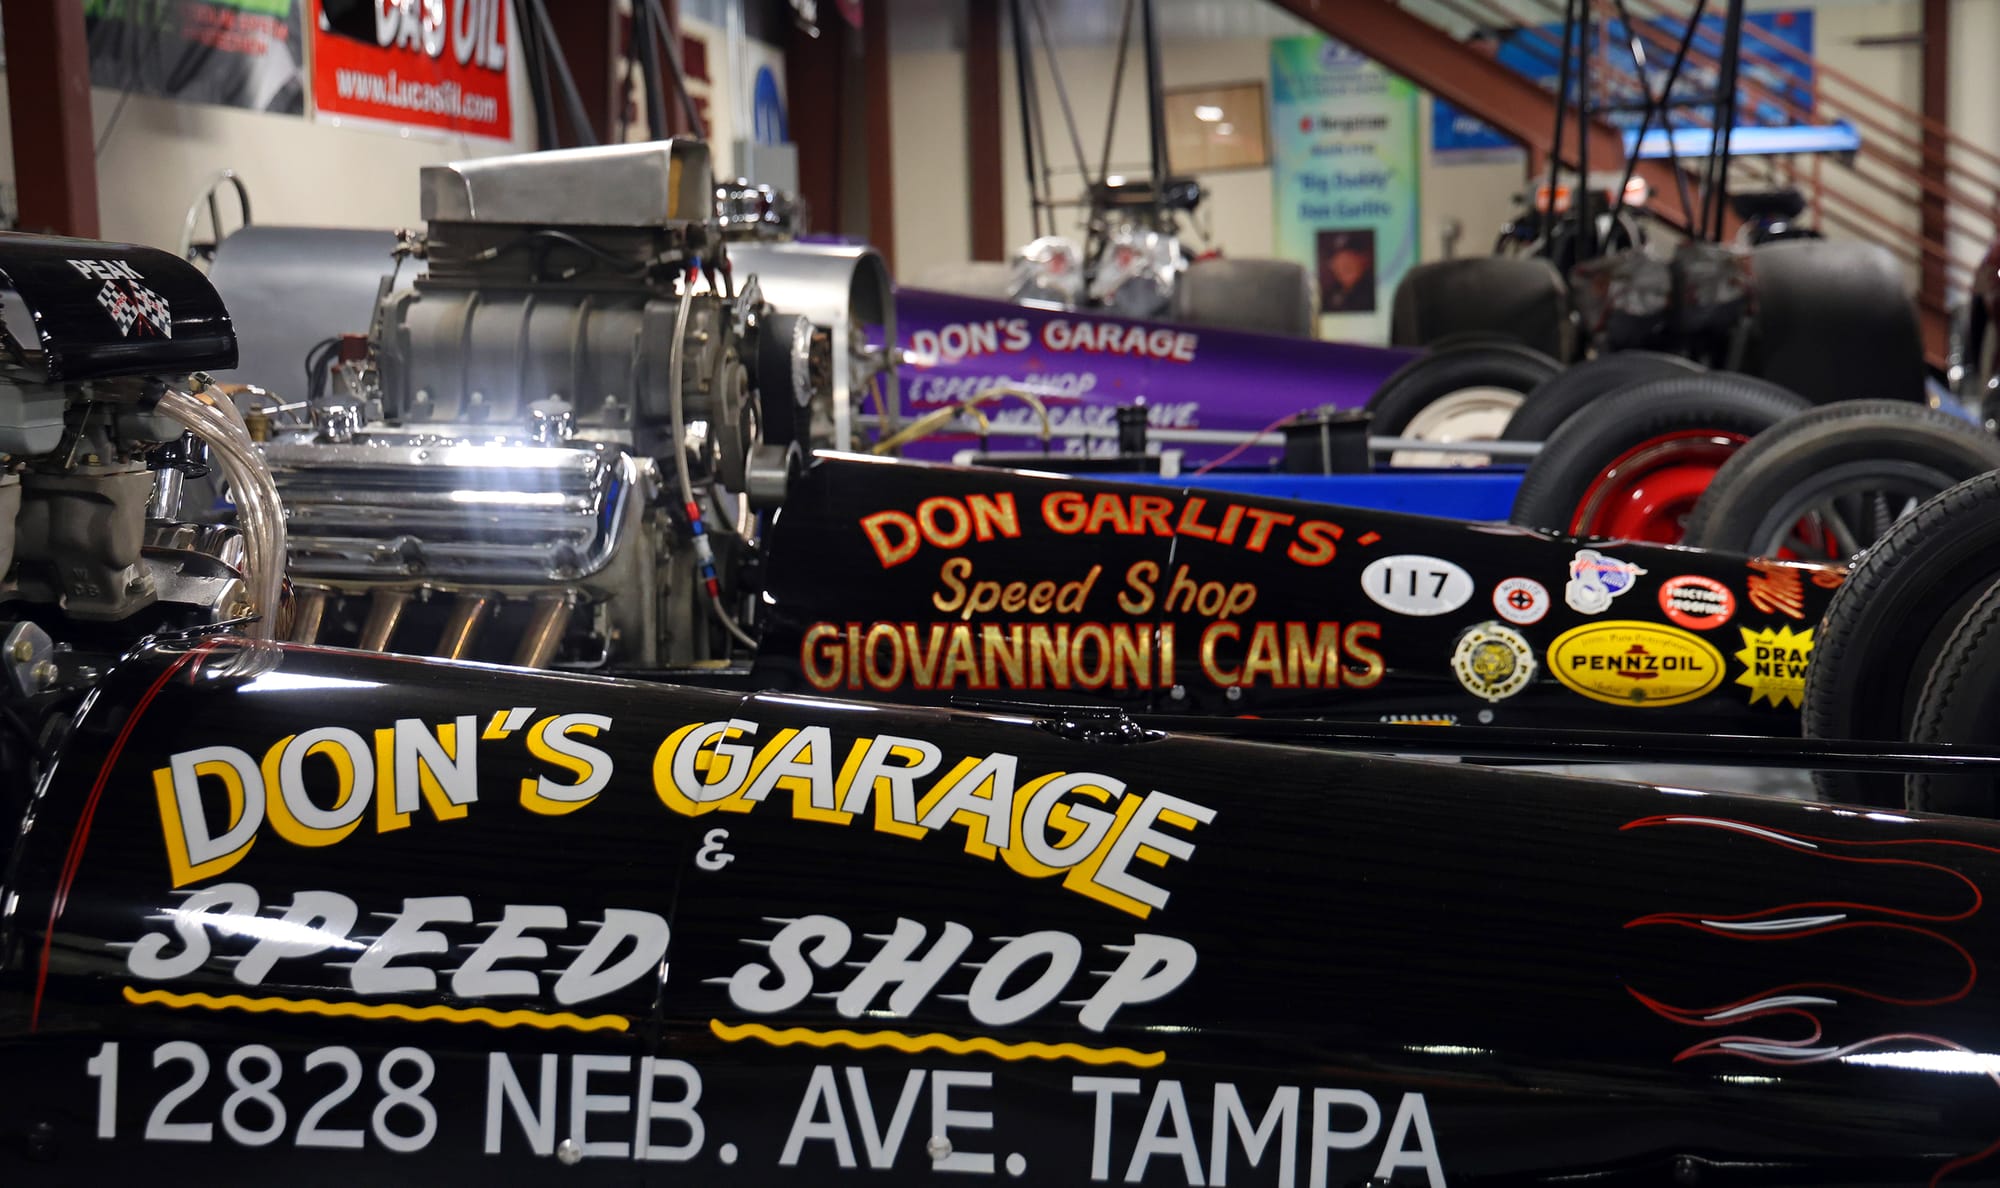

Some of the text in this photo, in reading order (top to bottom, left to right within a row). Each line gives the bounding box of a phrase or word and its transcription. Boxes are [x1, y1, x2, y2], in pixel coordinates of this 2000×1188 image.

[66, 259, 145, 279] PEAK
[911, 318, 1199, 367] DON'S GARAGE
[860, 492, 1021, 568] DON
[932, 557, 1101, 620] Speed
[1384, 567, 1449, 599] 117
[801, 621, 1385, 690] GIOVANNONI CAMS
[1572, 655, 1703, 671] PENNZOIL
[1754, 662, 1808, 679] NEW
[1755, 647, 1811, 662] DRA
[153, 707, 1217, 919] DON'S GARAGE
[696, 829, 734, 870] &
[120, 882, 1198, 1033] SPEED SHOP
[87, 1041, 1445, 1188] 12828 NEB. AVE. TAMPA
